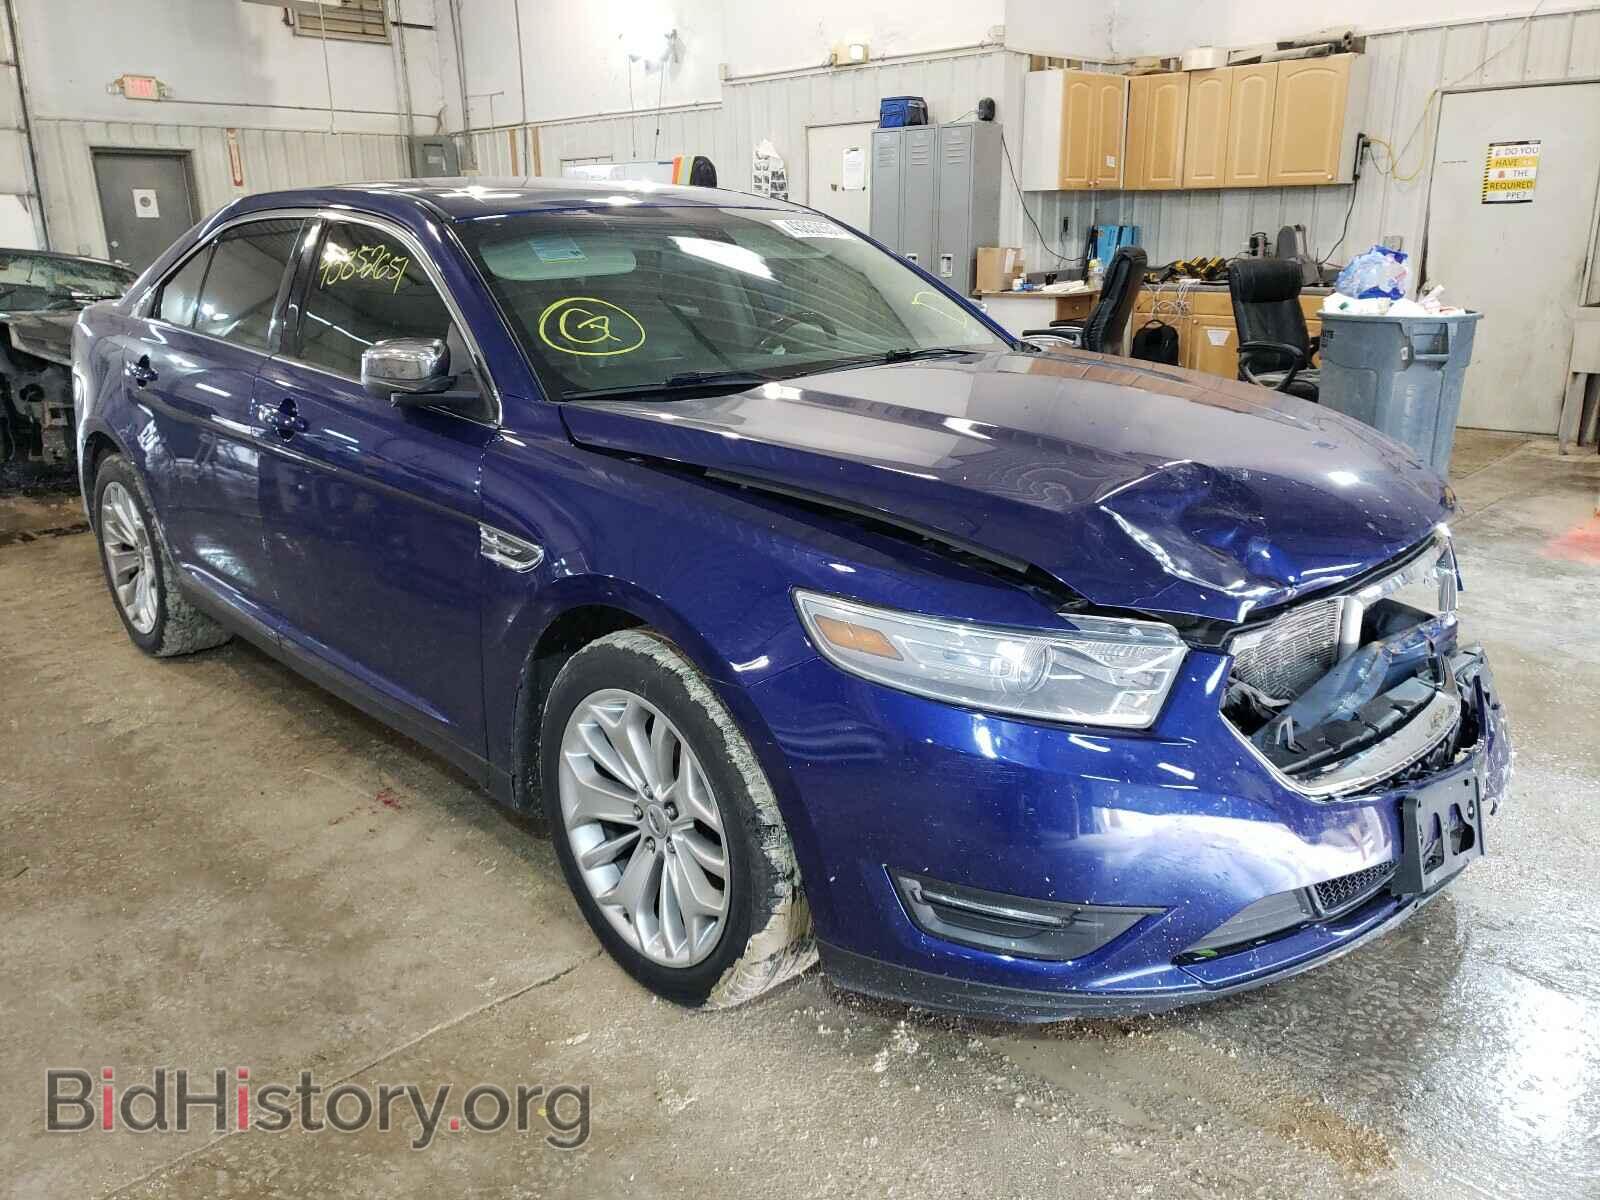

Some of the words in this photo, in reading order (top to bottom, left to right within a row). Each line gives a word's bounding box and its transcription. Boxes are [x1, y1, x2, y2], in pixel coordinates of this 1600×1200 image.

[1504, 147, 1518, 156] DO
[1520, 146, 1539, 154] YOU
[1495, 158, 1520, 167] HAVE
[1489, 181, 1533, 190] REQUIRED
